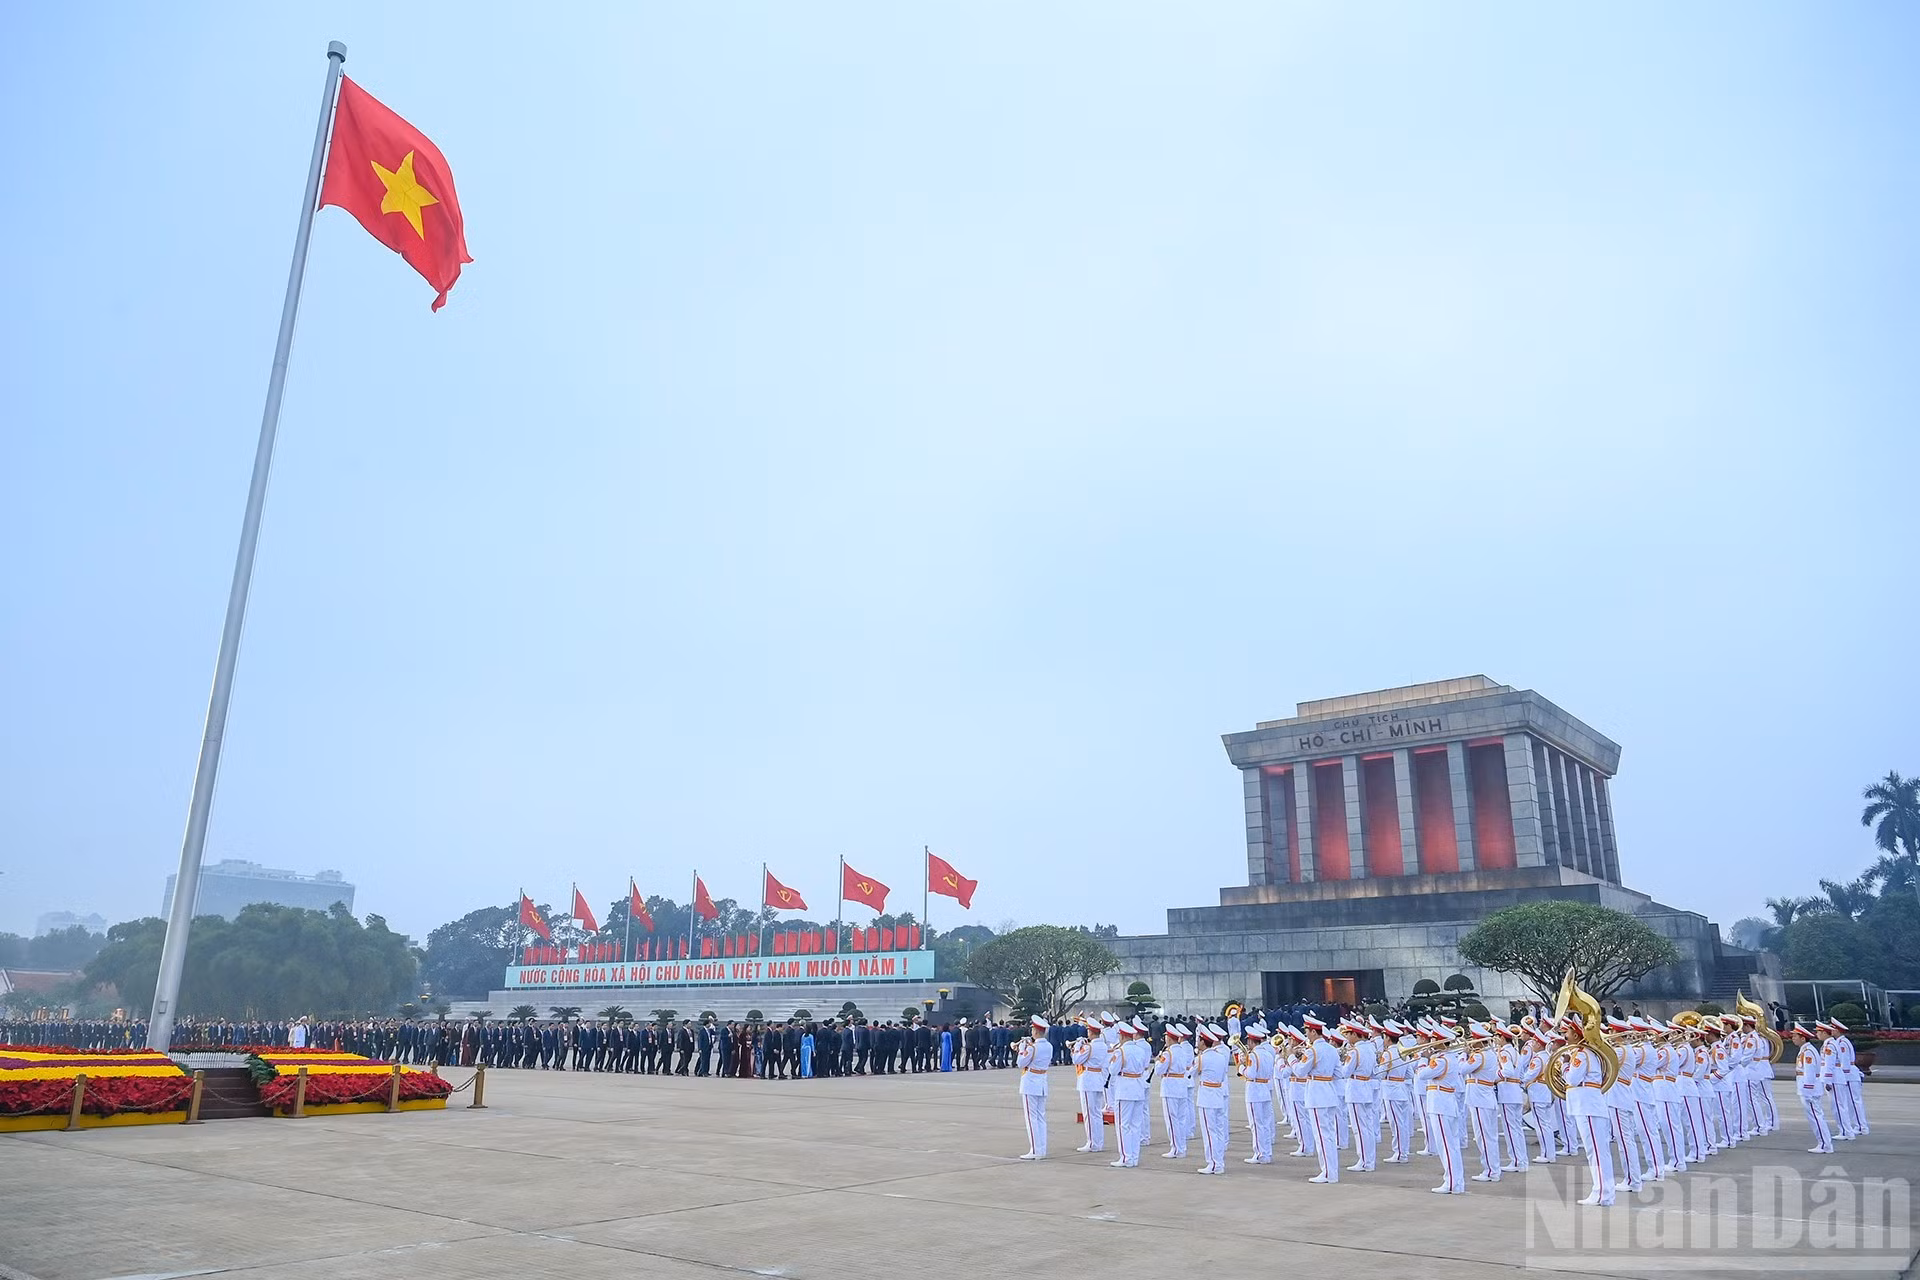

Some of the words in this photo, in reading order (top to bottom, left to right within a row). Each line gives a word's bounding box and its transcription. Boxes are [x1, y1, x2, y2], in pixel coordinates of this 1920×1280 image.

[519, 969, 547, 984] NƯỚC
[551, 966, 580, 985] CỘNG
[584, 965, 606, 983] HÒA
[610, 965, 626, 982] XÃ
[630, 963, 650, 984] HỘI
[655, 961, 681, 980] CHỦ
[685, 962, 725, 980] NGHĨA
[732, 959, 762, 981] VIỆT
[768, 961, 800, 978] NAM
[806, 956, 852, 977] MUÔN
[858, 954, 895, 976] NĂM
